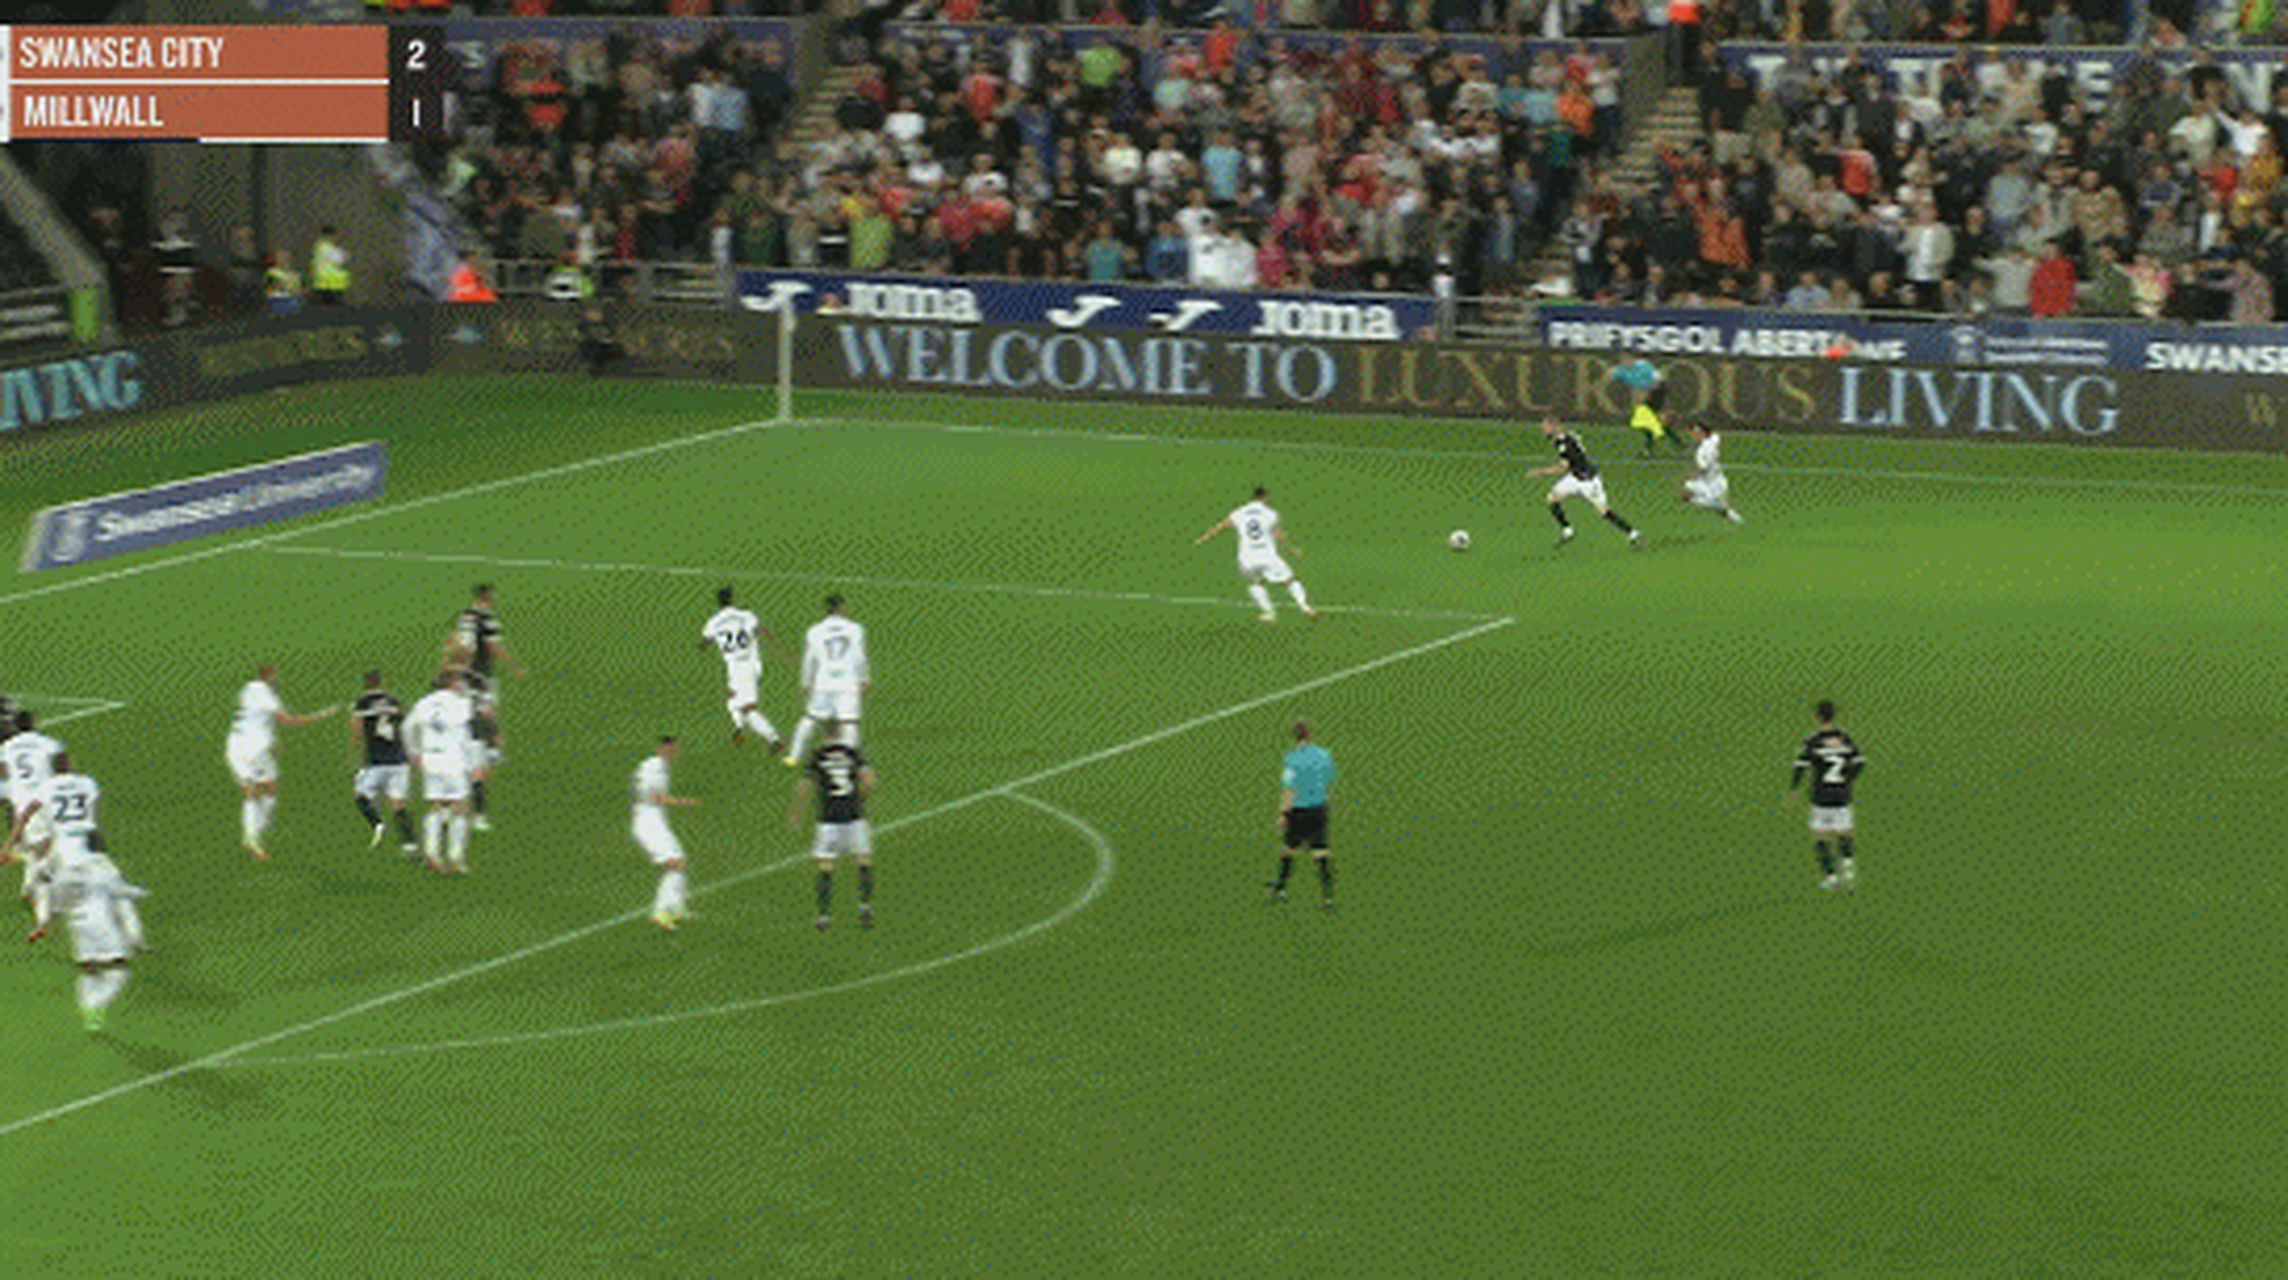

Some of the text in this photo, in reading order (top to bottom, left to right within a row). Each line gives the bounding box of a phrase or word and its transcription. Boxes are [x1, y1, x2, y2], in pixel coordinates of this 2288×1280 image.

[1548, 321, 1729, 355] PRIFYSGOL
[837, 323, 2122, 437] WELCOME TO LUXUROUS LIVING
[1245, 518, 1264, 541] 8
[717, 629, 751, 653] 26
[1821, 755, 1846, 783] 2
[52, 794, 89, 822] 23
